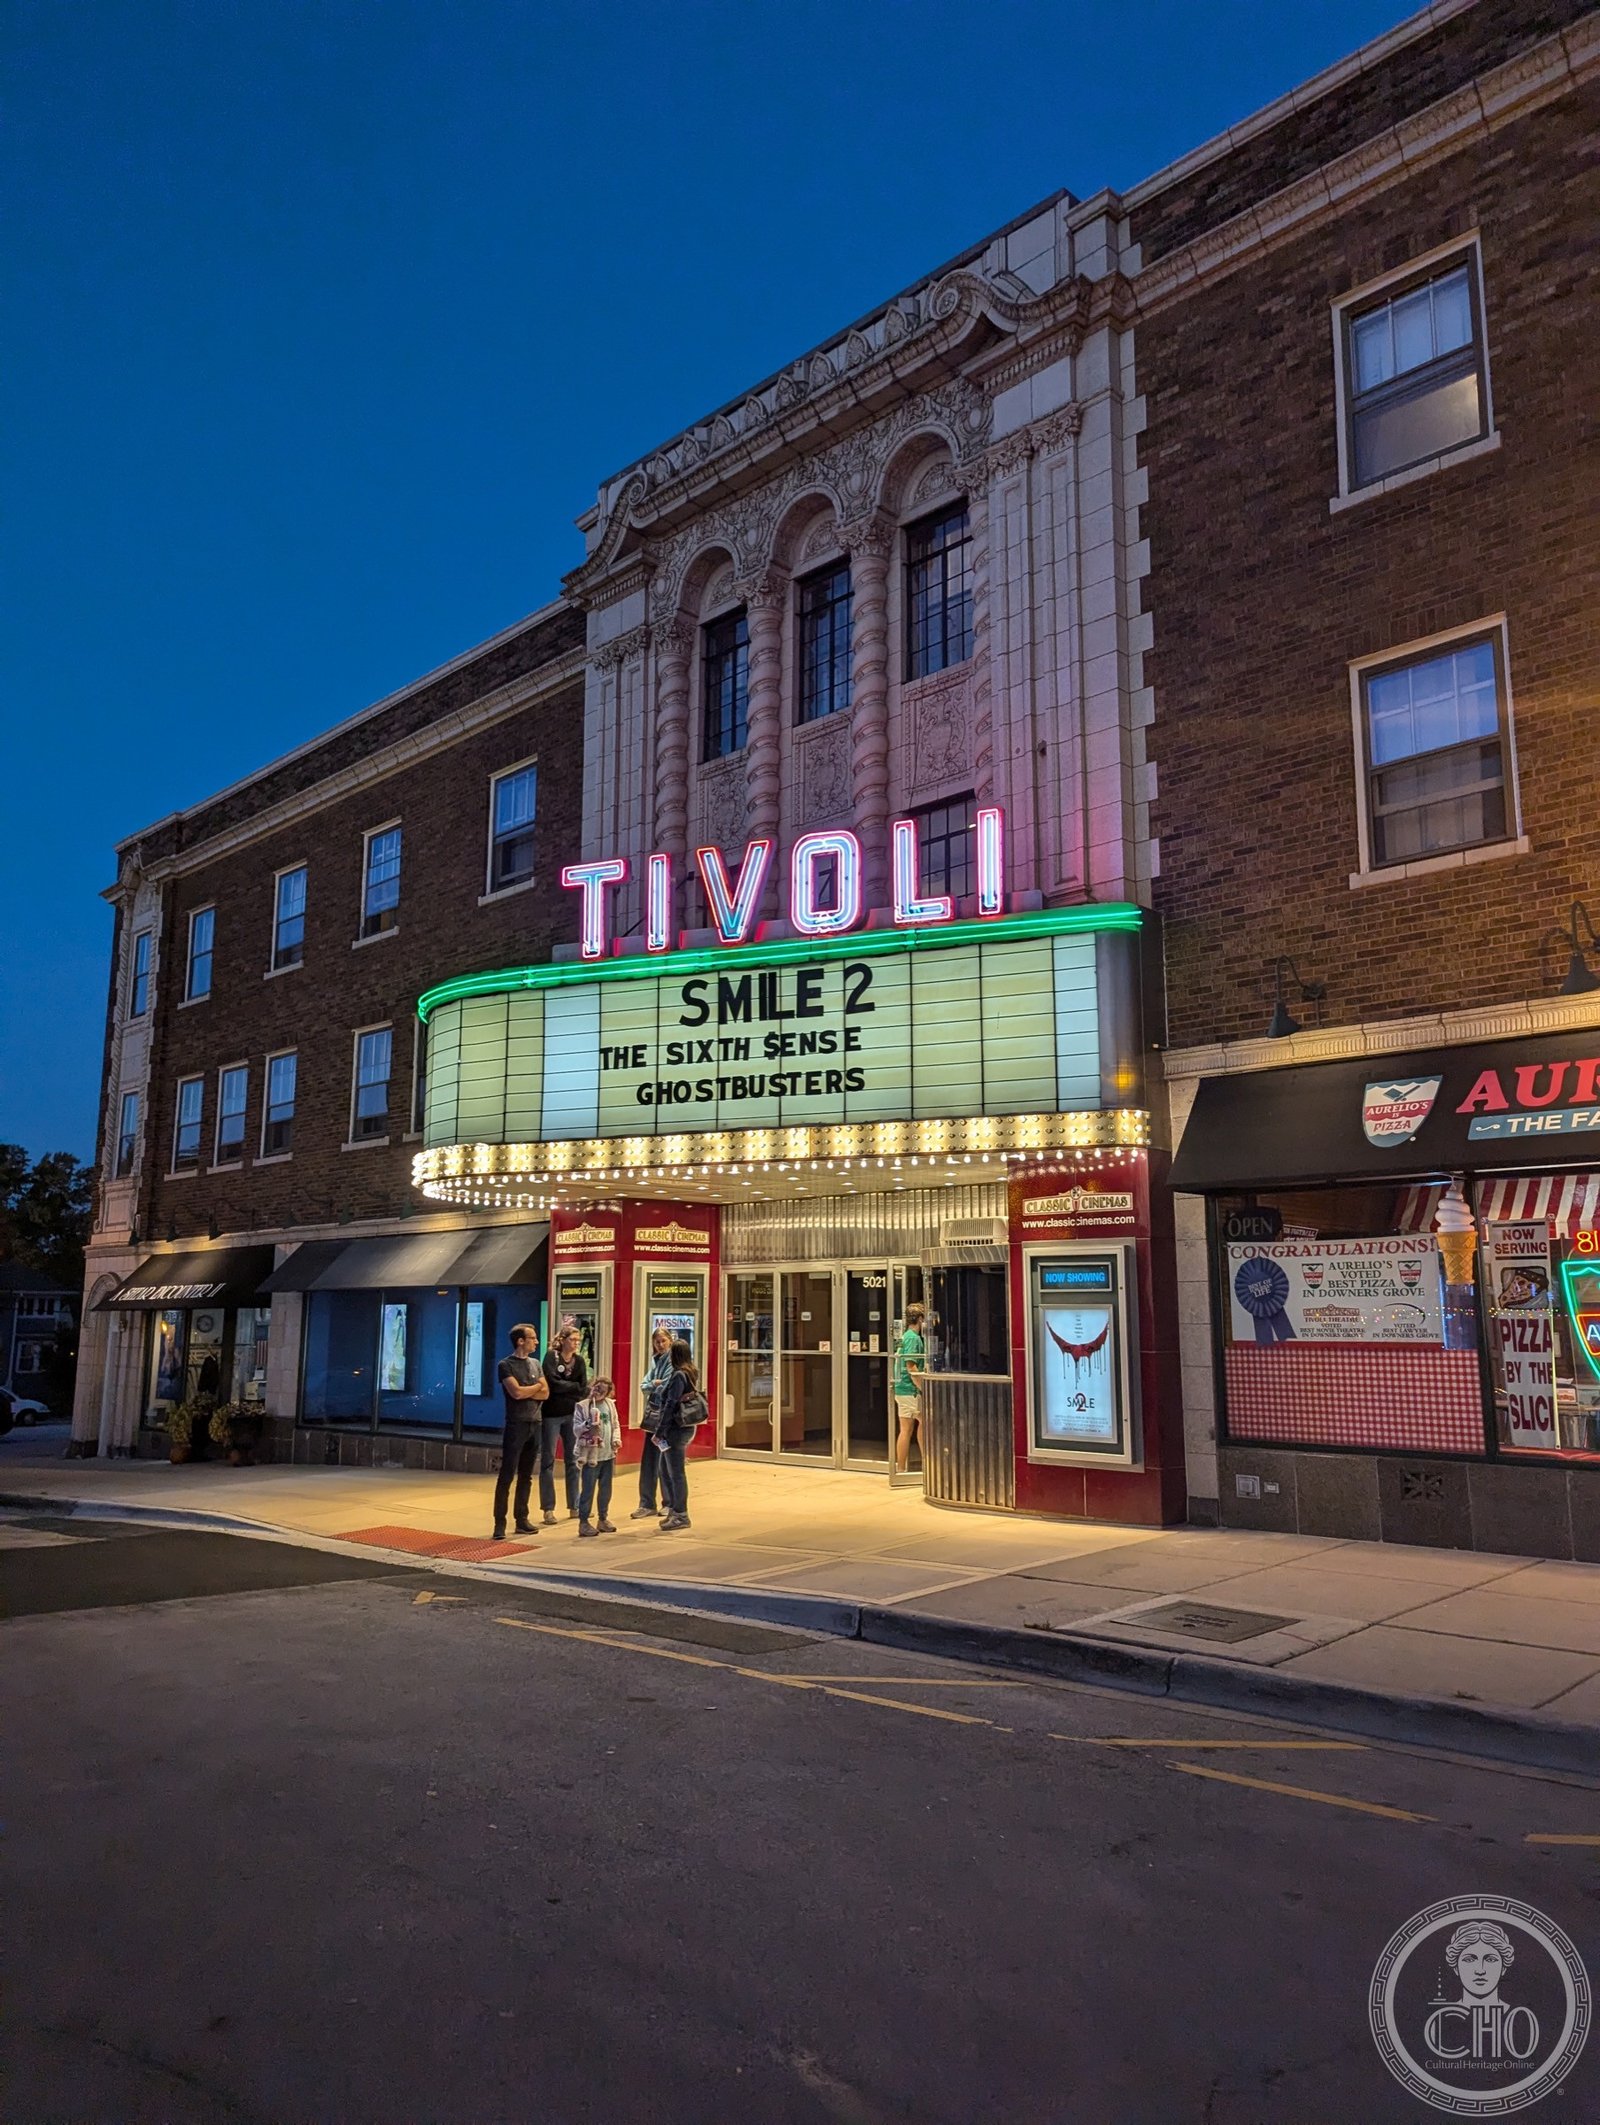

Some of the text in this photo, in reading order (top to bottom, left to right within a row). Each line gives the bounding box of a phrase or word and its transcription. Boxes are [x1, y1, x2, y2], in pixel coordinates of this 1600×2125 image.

[562, 807, 1005, 959] TIVOLI
[679, 963, 875, 1027] SMILE 2
[600, 1044, 648, 1070] THE
[667, 1037, 750, 1066] SIXTH
[636, 1067, 865, 1106] GHOSTBUSTERS
[1366, 1101, 1429, 1116] AURELIO'S
[1373, 1120, 1412, 1132] PIZZA
[1507, 1114, 1563, 1133] THE
[1026, 1196, 1128, 1213] CLASSIC CINEMAS
[1022, 1216, 1135, 1228] www.classiccinemas.com
[1228, 1216, 1273, 1237] OPEN
[557, 1230, 613, 1242] CLASSIC CINEMAS
[637, 1230, 706, 1242] CLASSIC CINEMAS
[1502, 1229, 1535, 1241] NOW
[634, 1244, 710, 1254] www.classiccinemas.com
[1231, 1237, 1436, 1259] CONGRATULATIONS!
[1494, 1241, 1548, 1254] SERVING
[1328, 1260, 1393, 1270] AURELIO'S
[1045, 1272, 1105, 1283] NOW SHOWING
[1340, 1270, 1382, 1279] VOTED
[863, 1276, 886, 1289] 5021
[1328, 1279, 1396, 1288] BEST PIZZA
[562, 1287, 596, 1296] COMING SOON
[654, 1286, 696, 1294] COMING SOON
[1302, 1288, 1425, 1298] IN DOWNERS GROVE
[655, 1318, 692, 1328] MISSING
[1501, 1318, 1553, 1353] PIZZA
[1506, 1361, 1522, 1383] BY
[1075, 1392, 1087, 1412] 2
